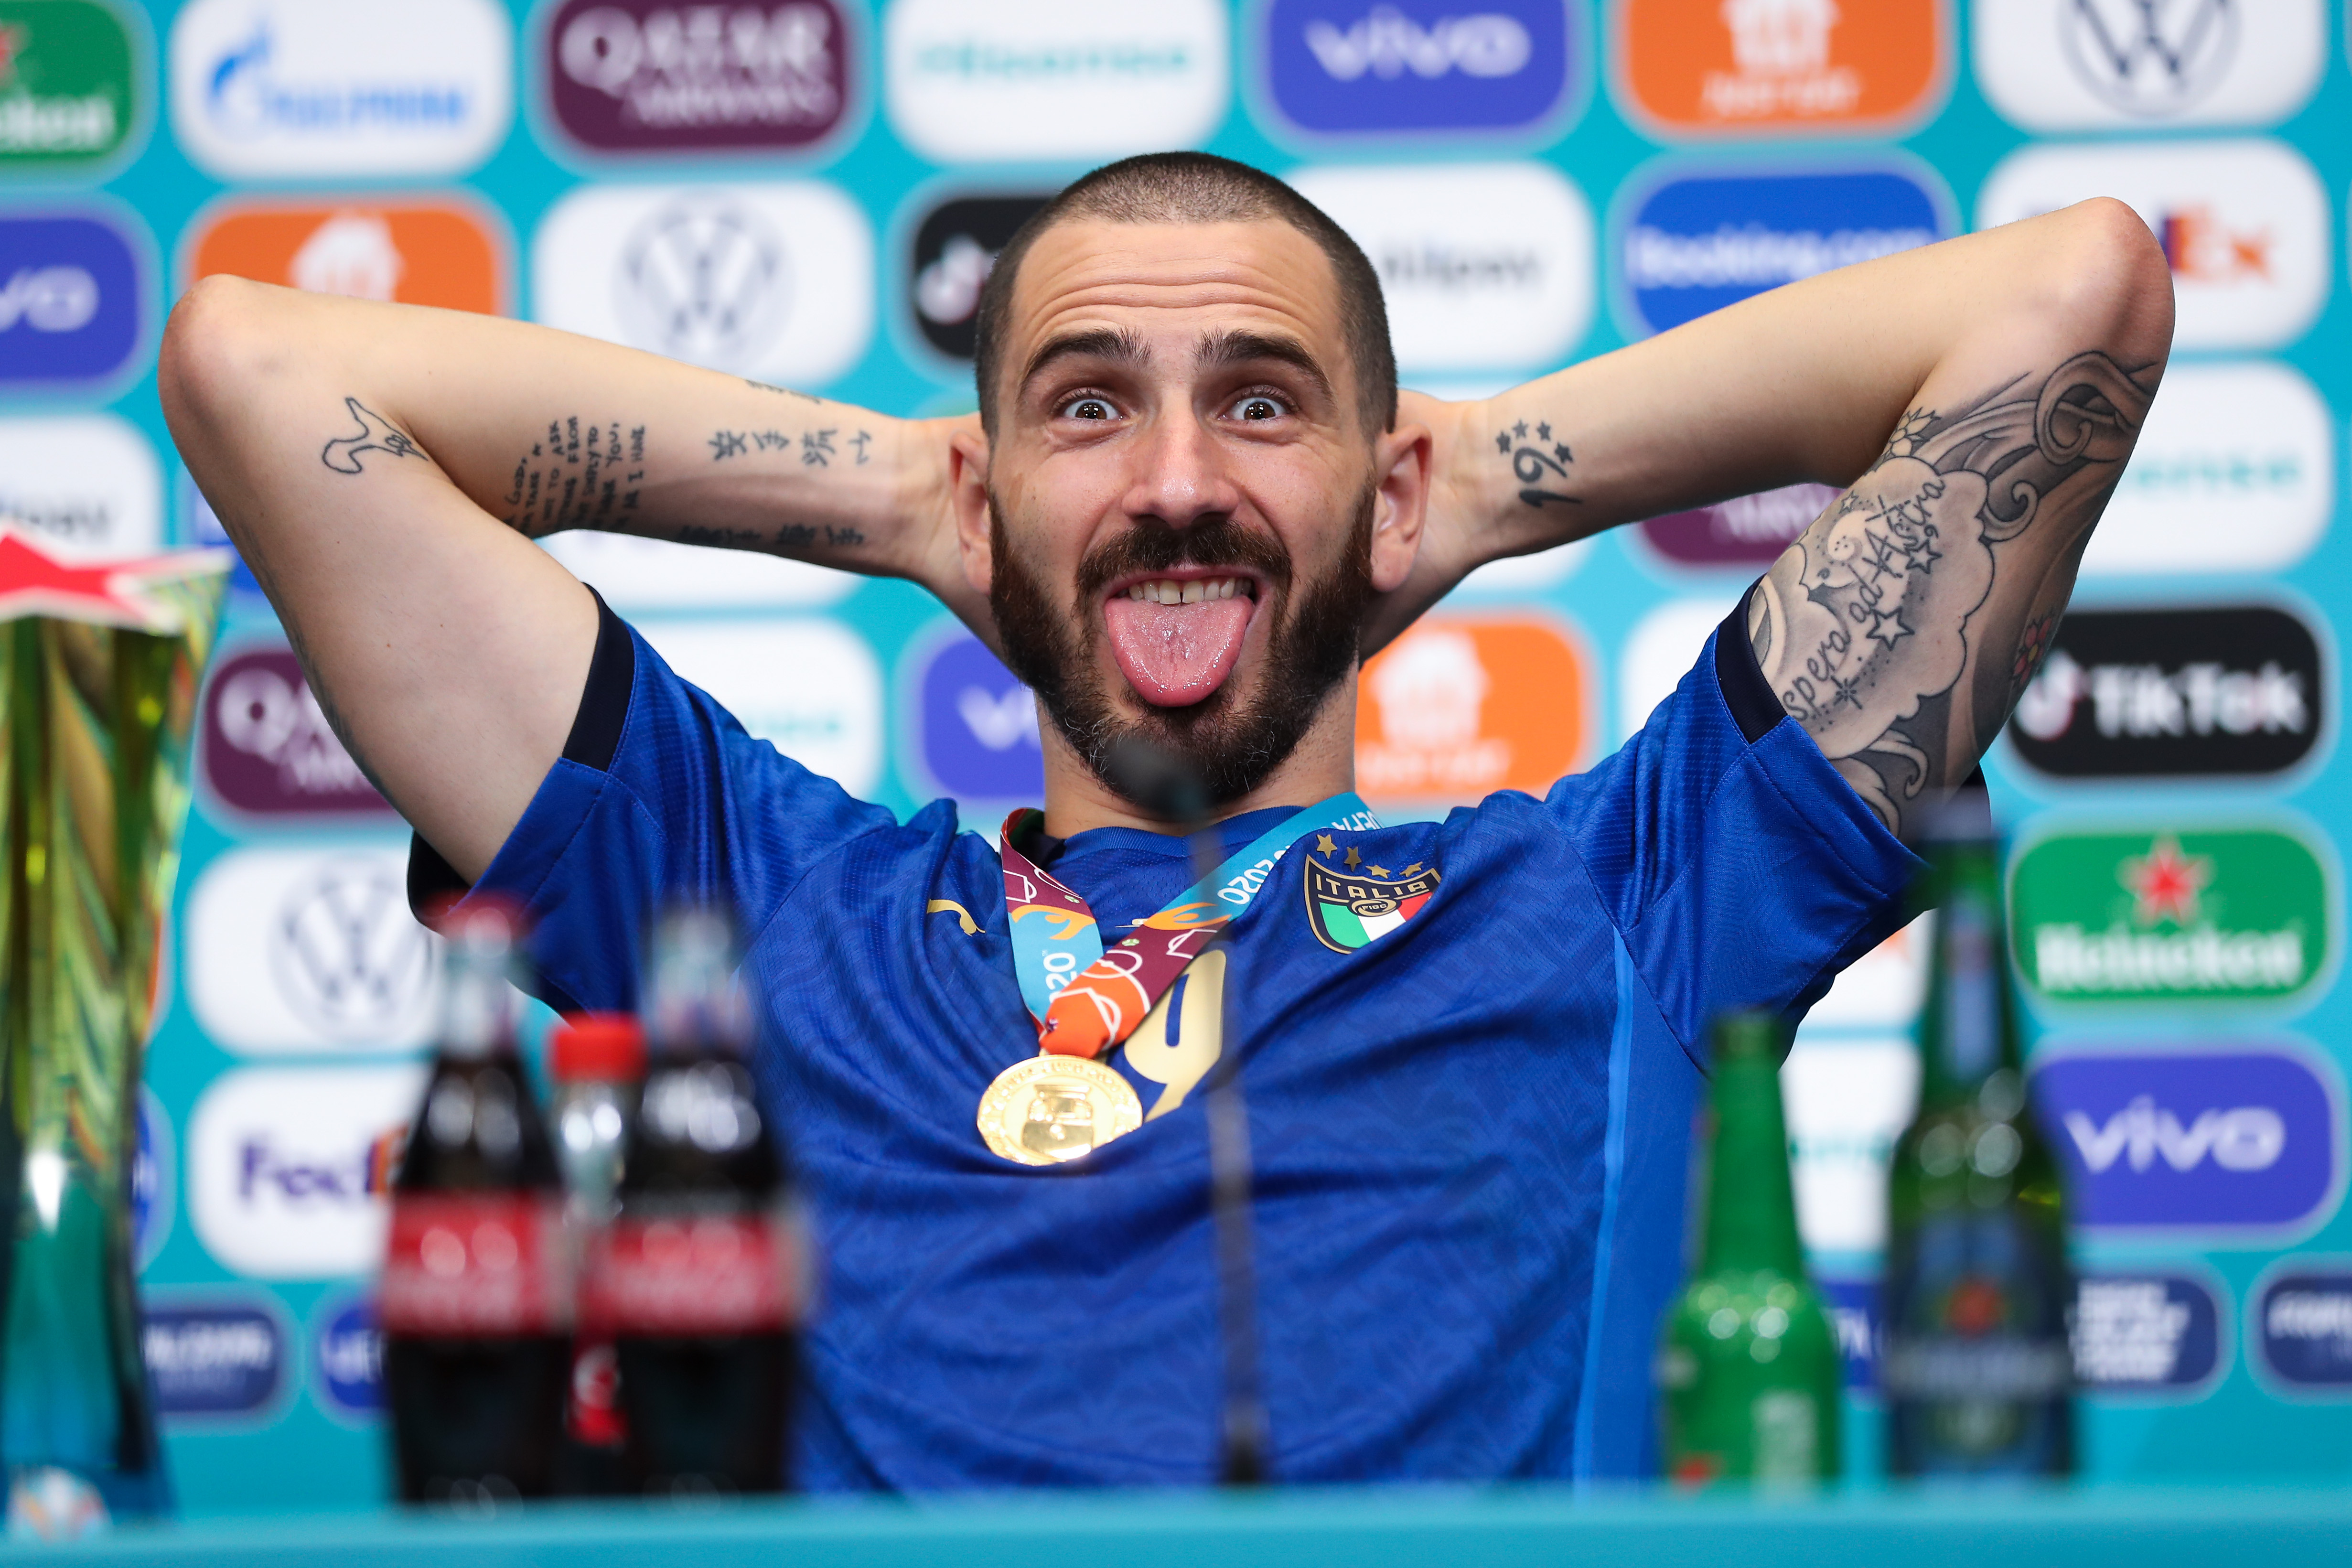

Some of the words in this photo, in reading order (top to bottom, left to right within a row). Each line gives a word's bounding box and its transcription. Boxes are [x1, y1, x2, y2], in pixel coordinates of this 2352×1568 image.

[1303, 4, 1531, 81] vivo
[1316, 873, 1428, 899] ITALIA
[1043, 952, 1077, 1004] 20
[2035, 924, 2305, 993] Heineken
[2063, 1093, 2287, 1173] vivo
